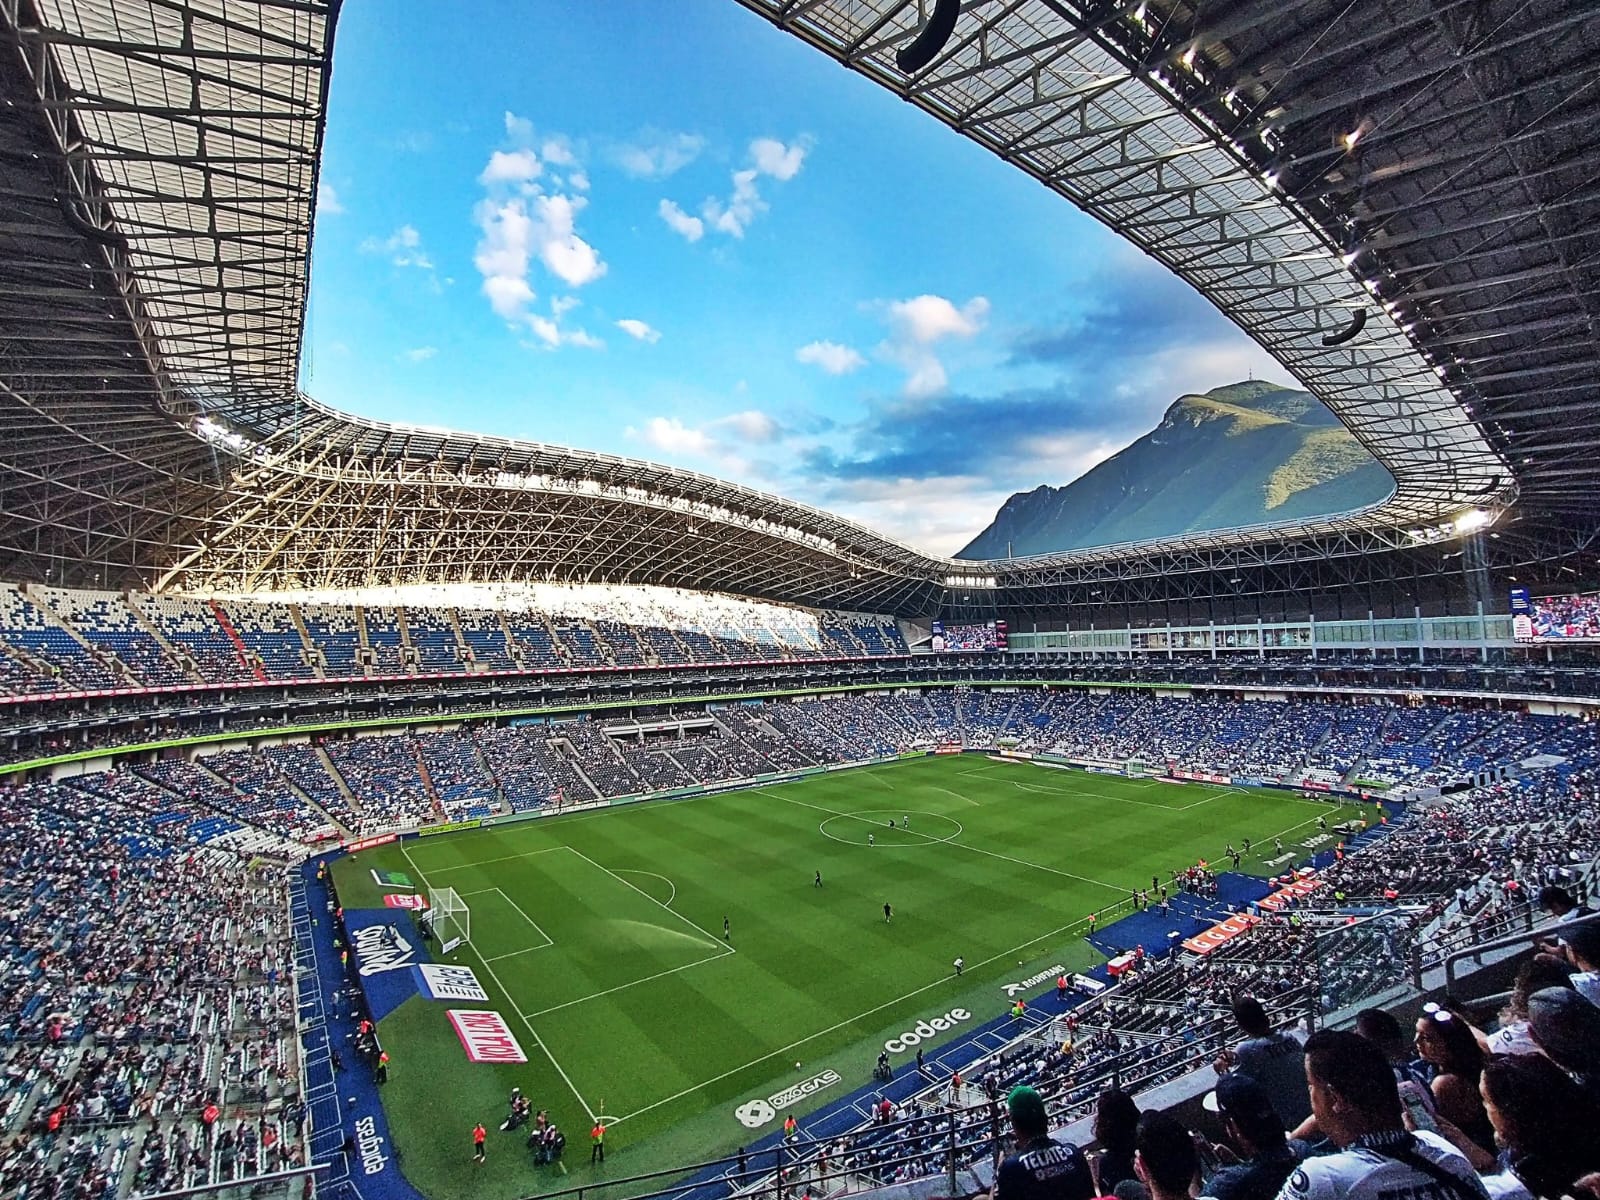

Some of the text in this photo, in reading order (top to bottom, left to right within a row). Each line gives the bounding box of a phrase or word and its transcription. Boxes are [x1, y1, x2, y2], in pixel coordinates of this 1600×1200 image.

[458, 1013, 521, 1059] KOLA LOKA
[885, 1008, 972, 1053] codere
[355, 1116, 389, 1174] epicgrass
